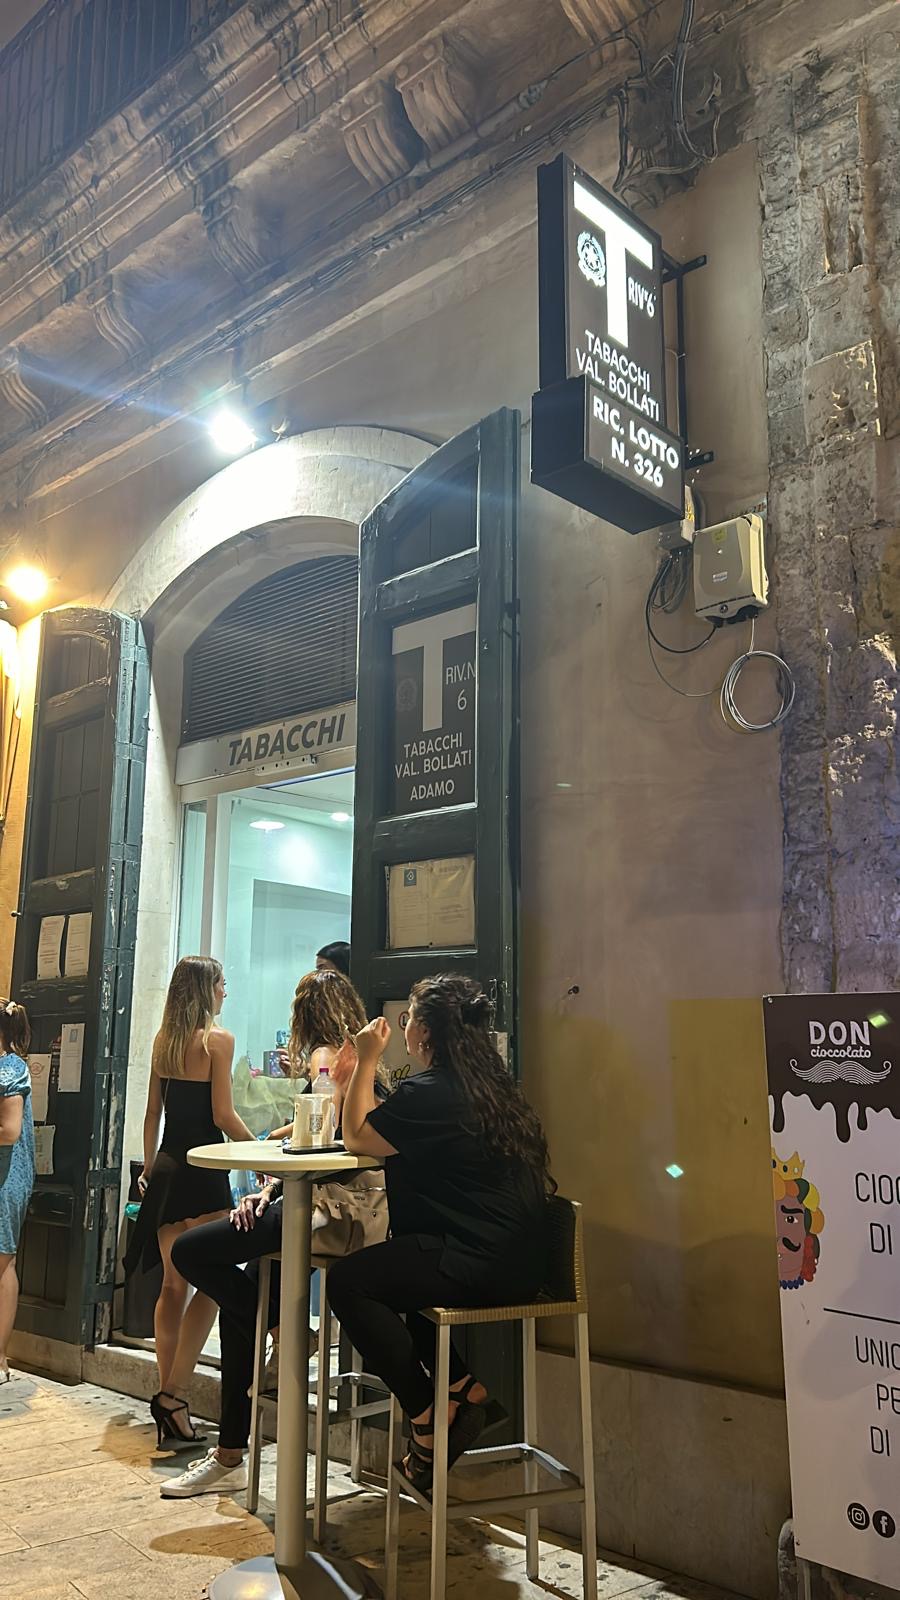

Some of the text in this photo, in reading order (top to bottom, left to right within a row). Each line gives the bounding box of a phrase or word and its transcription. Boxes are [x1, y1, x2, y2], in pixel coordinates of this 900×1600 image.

[585, 329, 650, 393] TABACCHI
[576, 347, 660, 422] VAL. BOLLATI
[593, 394, 680, 470] RIC. LOTTO
[611, 436, 664, 488] N. 326
[457, 688, 467, 711] 6
[228, 713, 347, 766] TABACCHI
[403, 731, 463, 758] TABACCHI
[395, 749, 472, 779] VAL. BOLLATI
[410, 779, 455, 801] ADAMO
[808, 1020, 871, 1046] DON
[810, 1045, 872, 1058] cioccolato
[869, 1222, 893, 1255] DI
[870, 1425, 890, 1457] DI
